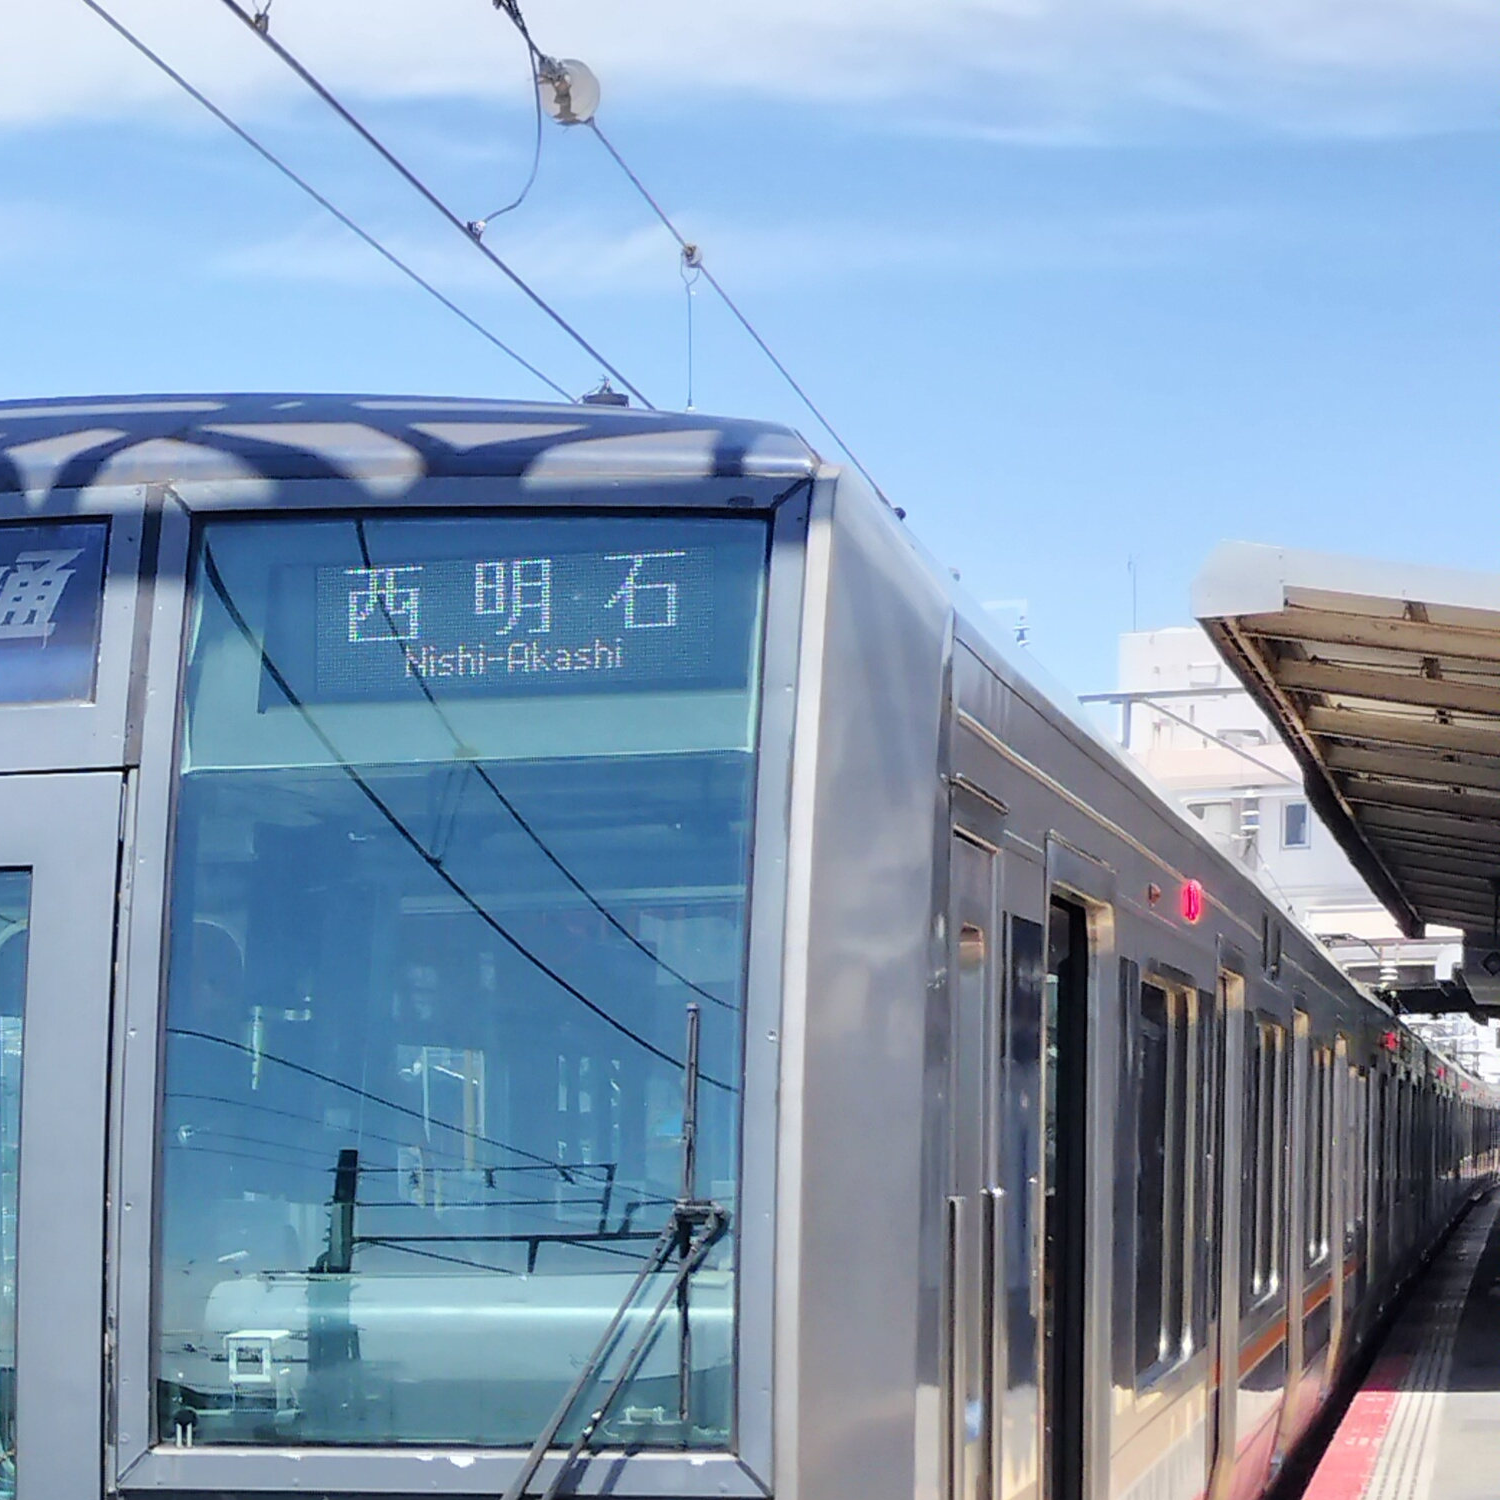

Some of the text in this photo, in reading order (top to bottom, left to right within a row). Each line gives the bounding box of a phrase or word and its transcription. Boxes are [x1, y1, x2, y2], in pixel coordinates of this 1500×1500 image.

[344, 551, 687, 643] 西明石
[405, 638, 624, 678] Nishi-Akashi
